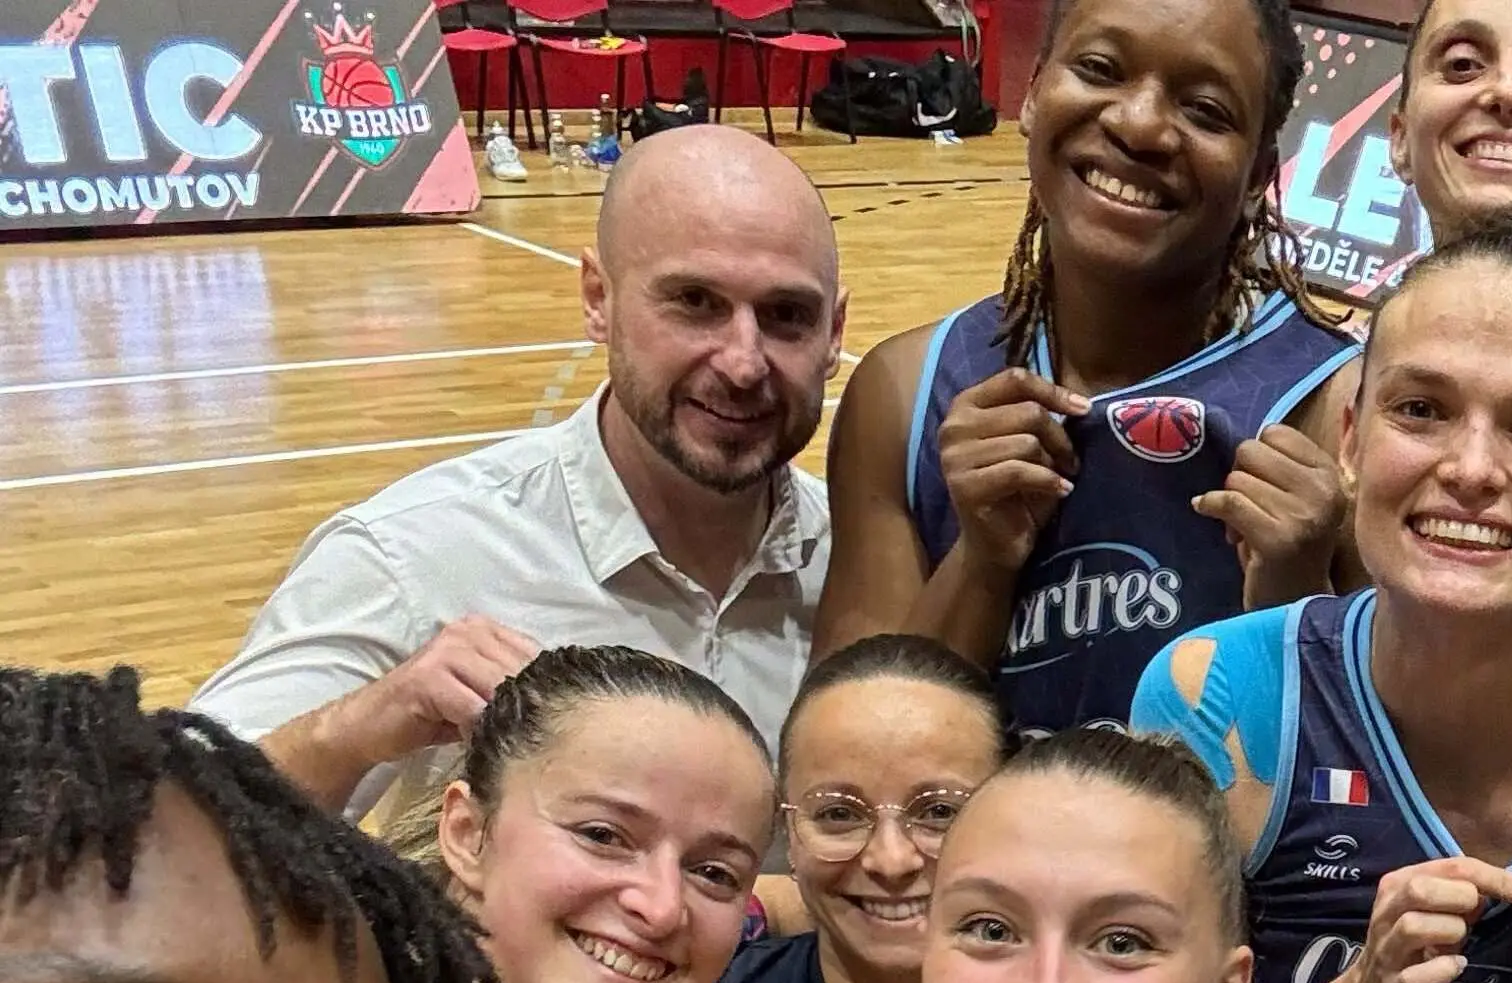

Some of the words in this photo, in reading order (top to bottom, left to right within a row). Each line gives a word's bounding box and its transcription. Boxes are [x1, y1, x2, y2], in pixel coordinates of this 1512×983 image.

[0, 42, 263, 163] TIC
[294, 103, 343, 136] KP
[344, 103, 432, 137] BRNO
[0, 171, 261, 217] CHOMUTOV
[1303, 862, 1361, 881] SKILLS
